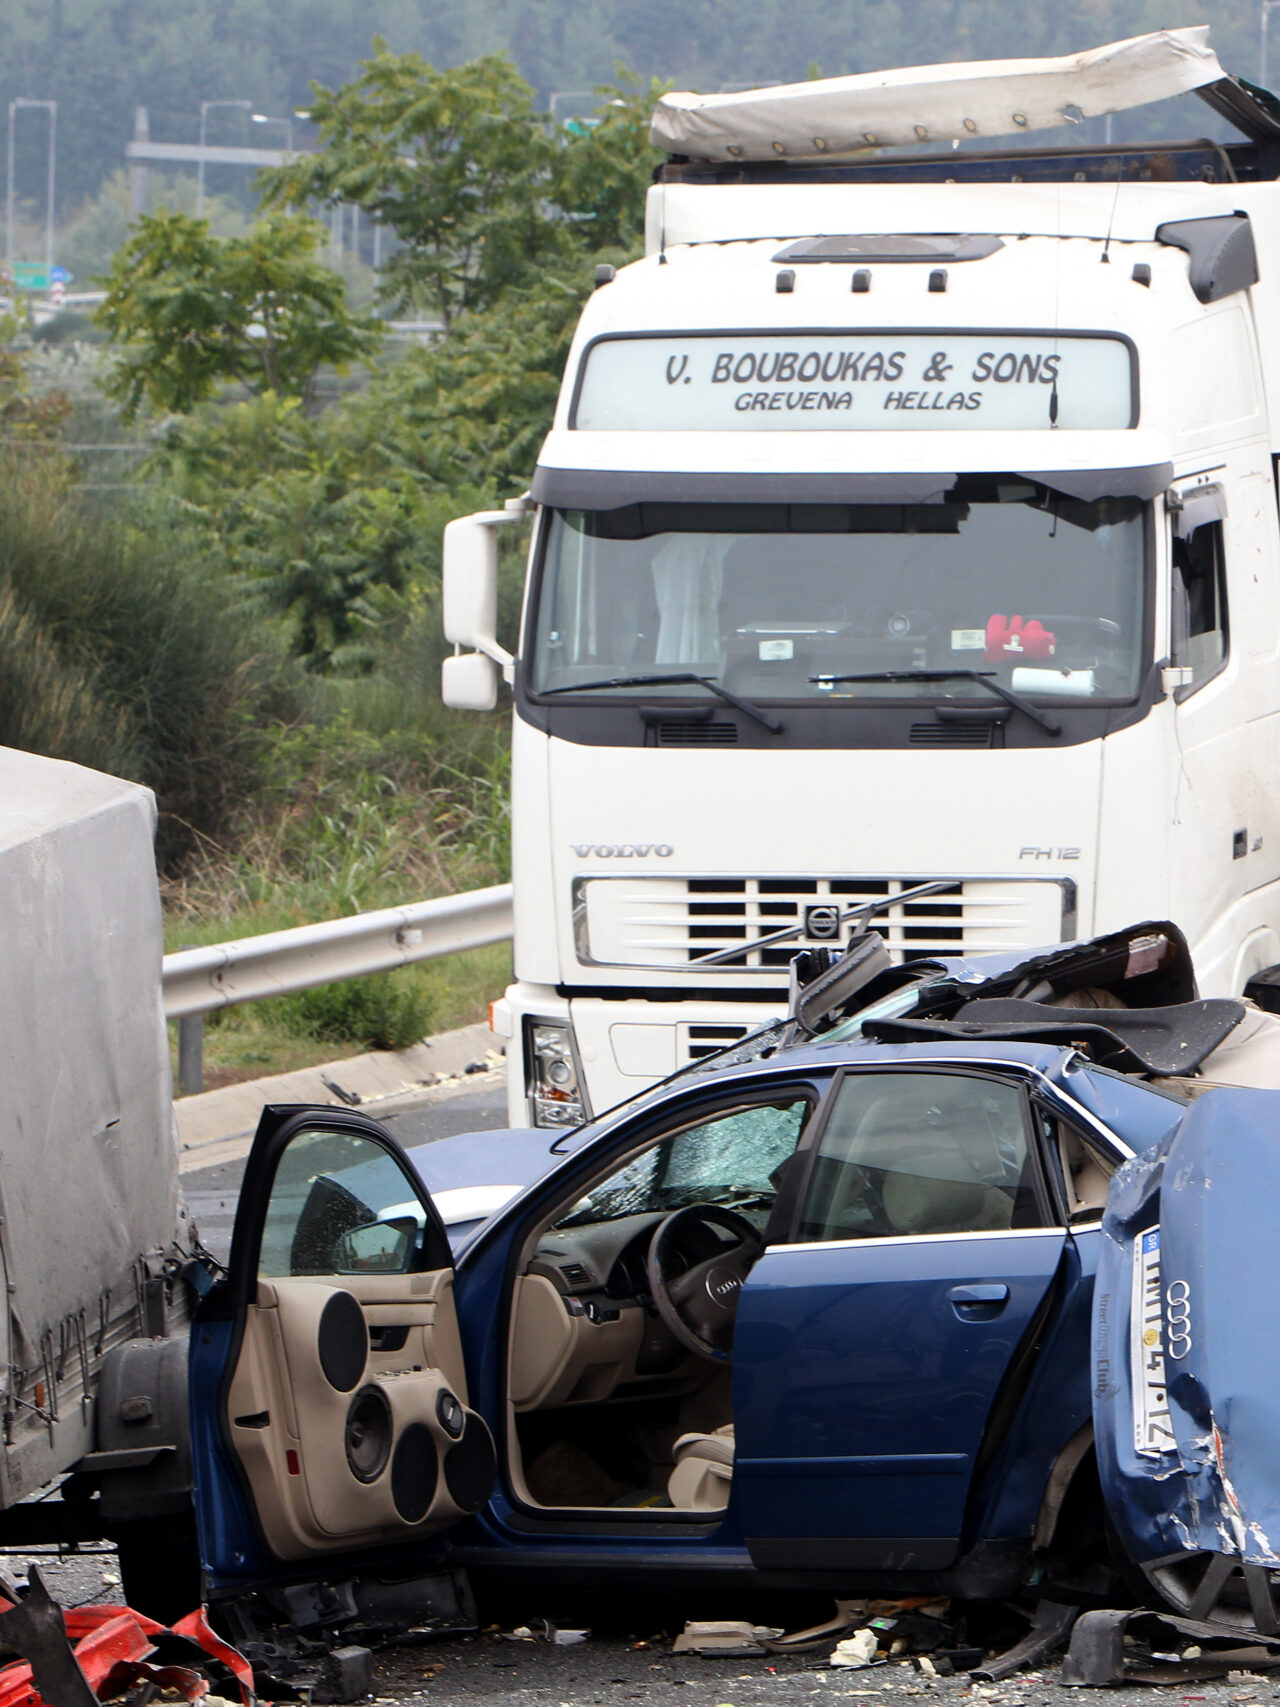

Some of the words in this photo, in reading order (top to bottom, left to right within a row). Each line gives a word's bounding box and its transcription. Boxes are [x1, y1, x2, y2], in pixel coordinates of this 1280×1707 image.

[666, 353, 691, 385] V.
[711, 351, 906, 384] BOUBOUKAS
[922, 352, 953, 382] &
[971, 352, 1061, 386] SONS
[734, 391, 853, 412] GREVENA
[883, 391, 983, 411] HELLAS
[568, 843, 675, 859] VOLVO
